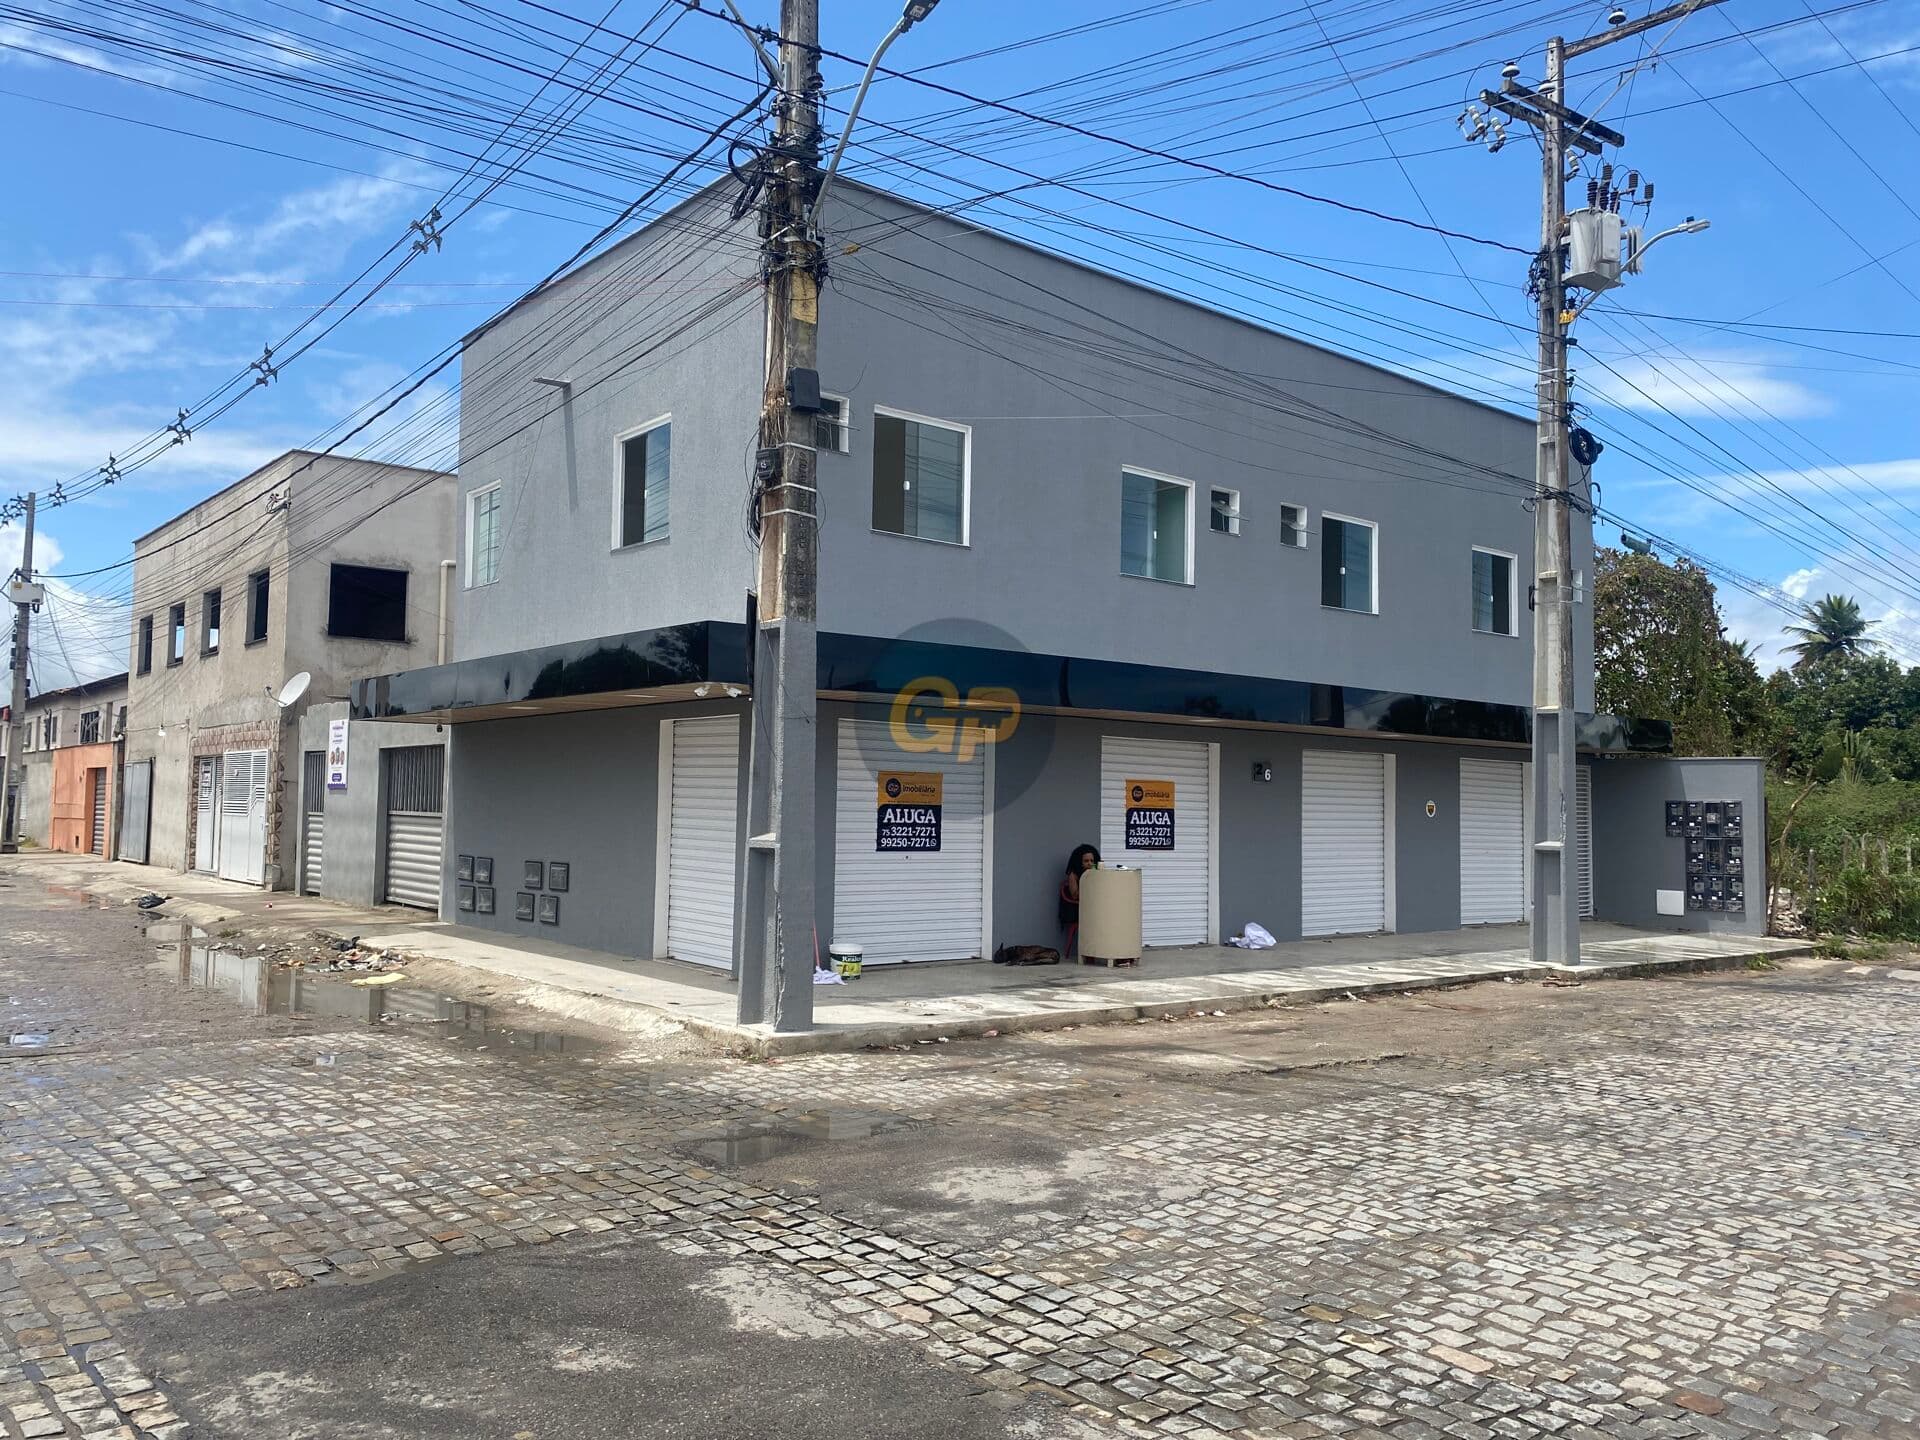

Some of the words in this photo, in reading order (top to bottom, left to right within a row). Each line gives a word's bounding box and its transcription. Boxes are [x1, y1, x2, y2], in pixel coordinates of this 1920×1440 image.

[883, 808, 937, 824] ALUGA
[1130, 811, 1171, 825] ALUGA
[882, 828, 890, 836] 75
[891, 826, 937, 837] 3221-7271
[1136, 827, 1171, 836] 3221-7271
[880, 837, 930, 848] 99250-7271
[1128, 837, 1166, 846] 99250-7271
